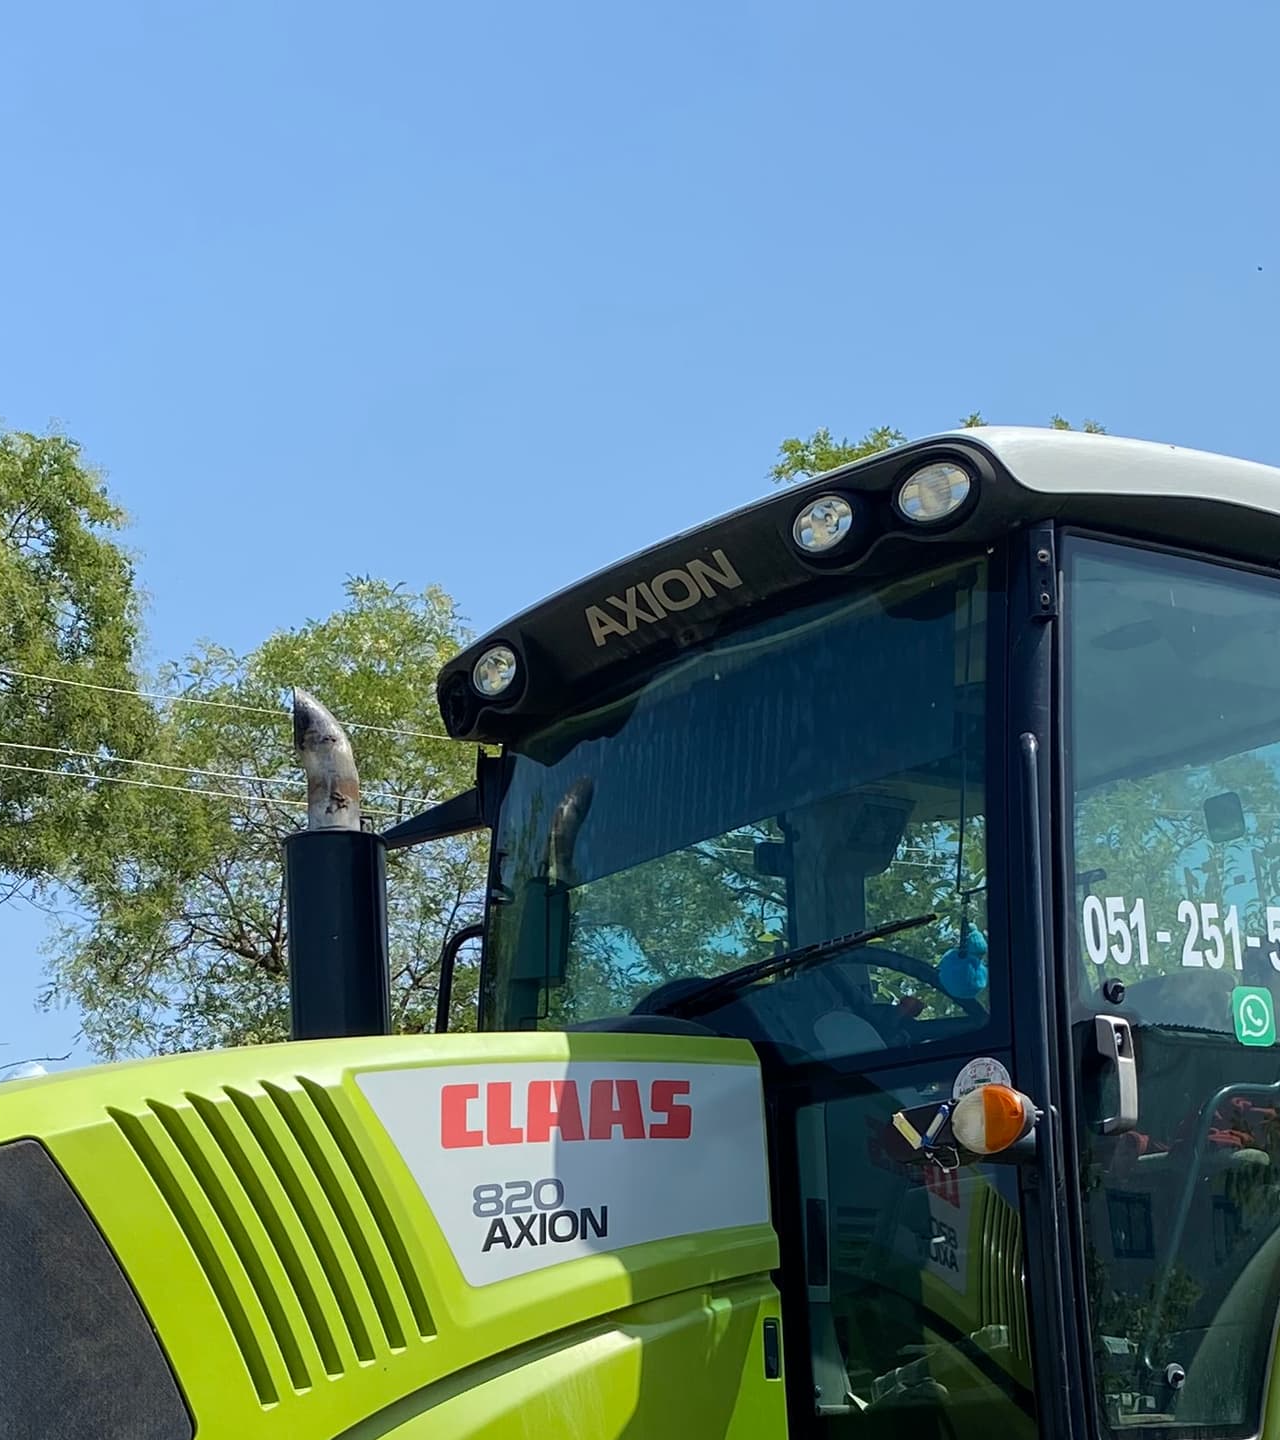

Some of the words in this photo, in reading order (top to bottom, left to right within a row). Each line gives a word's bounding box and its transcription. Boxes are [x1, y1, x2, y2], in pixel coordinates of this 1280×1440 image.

[584, 549, 743, 647] AXION
[441, 1079, 692, 1149] CLAAS
[473, 1177, 565, 1218] 820
[482, 1205, 608, 1252] AXION
